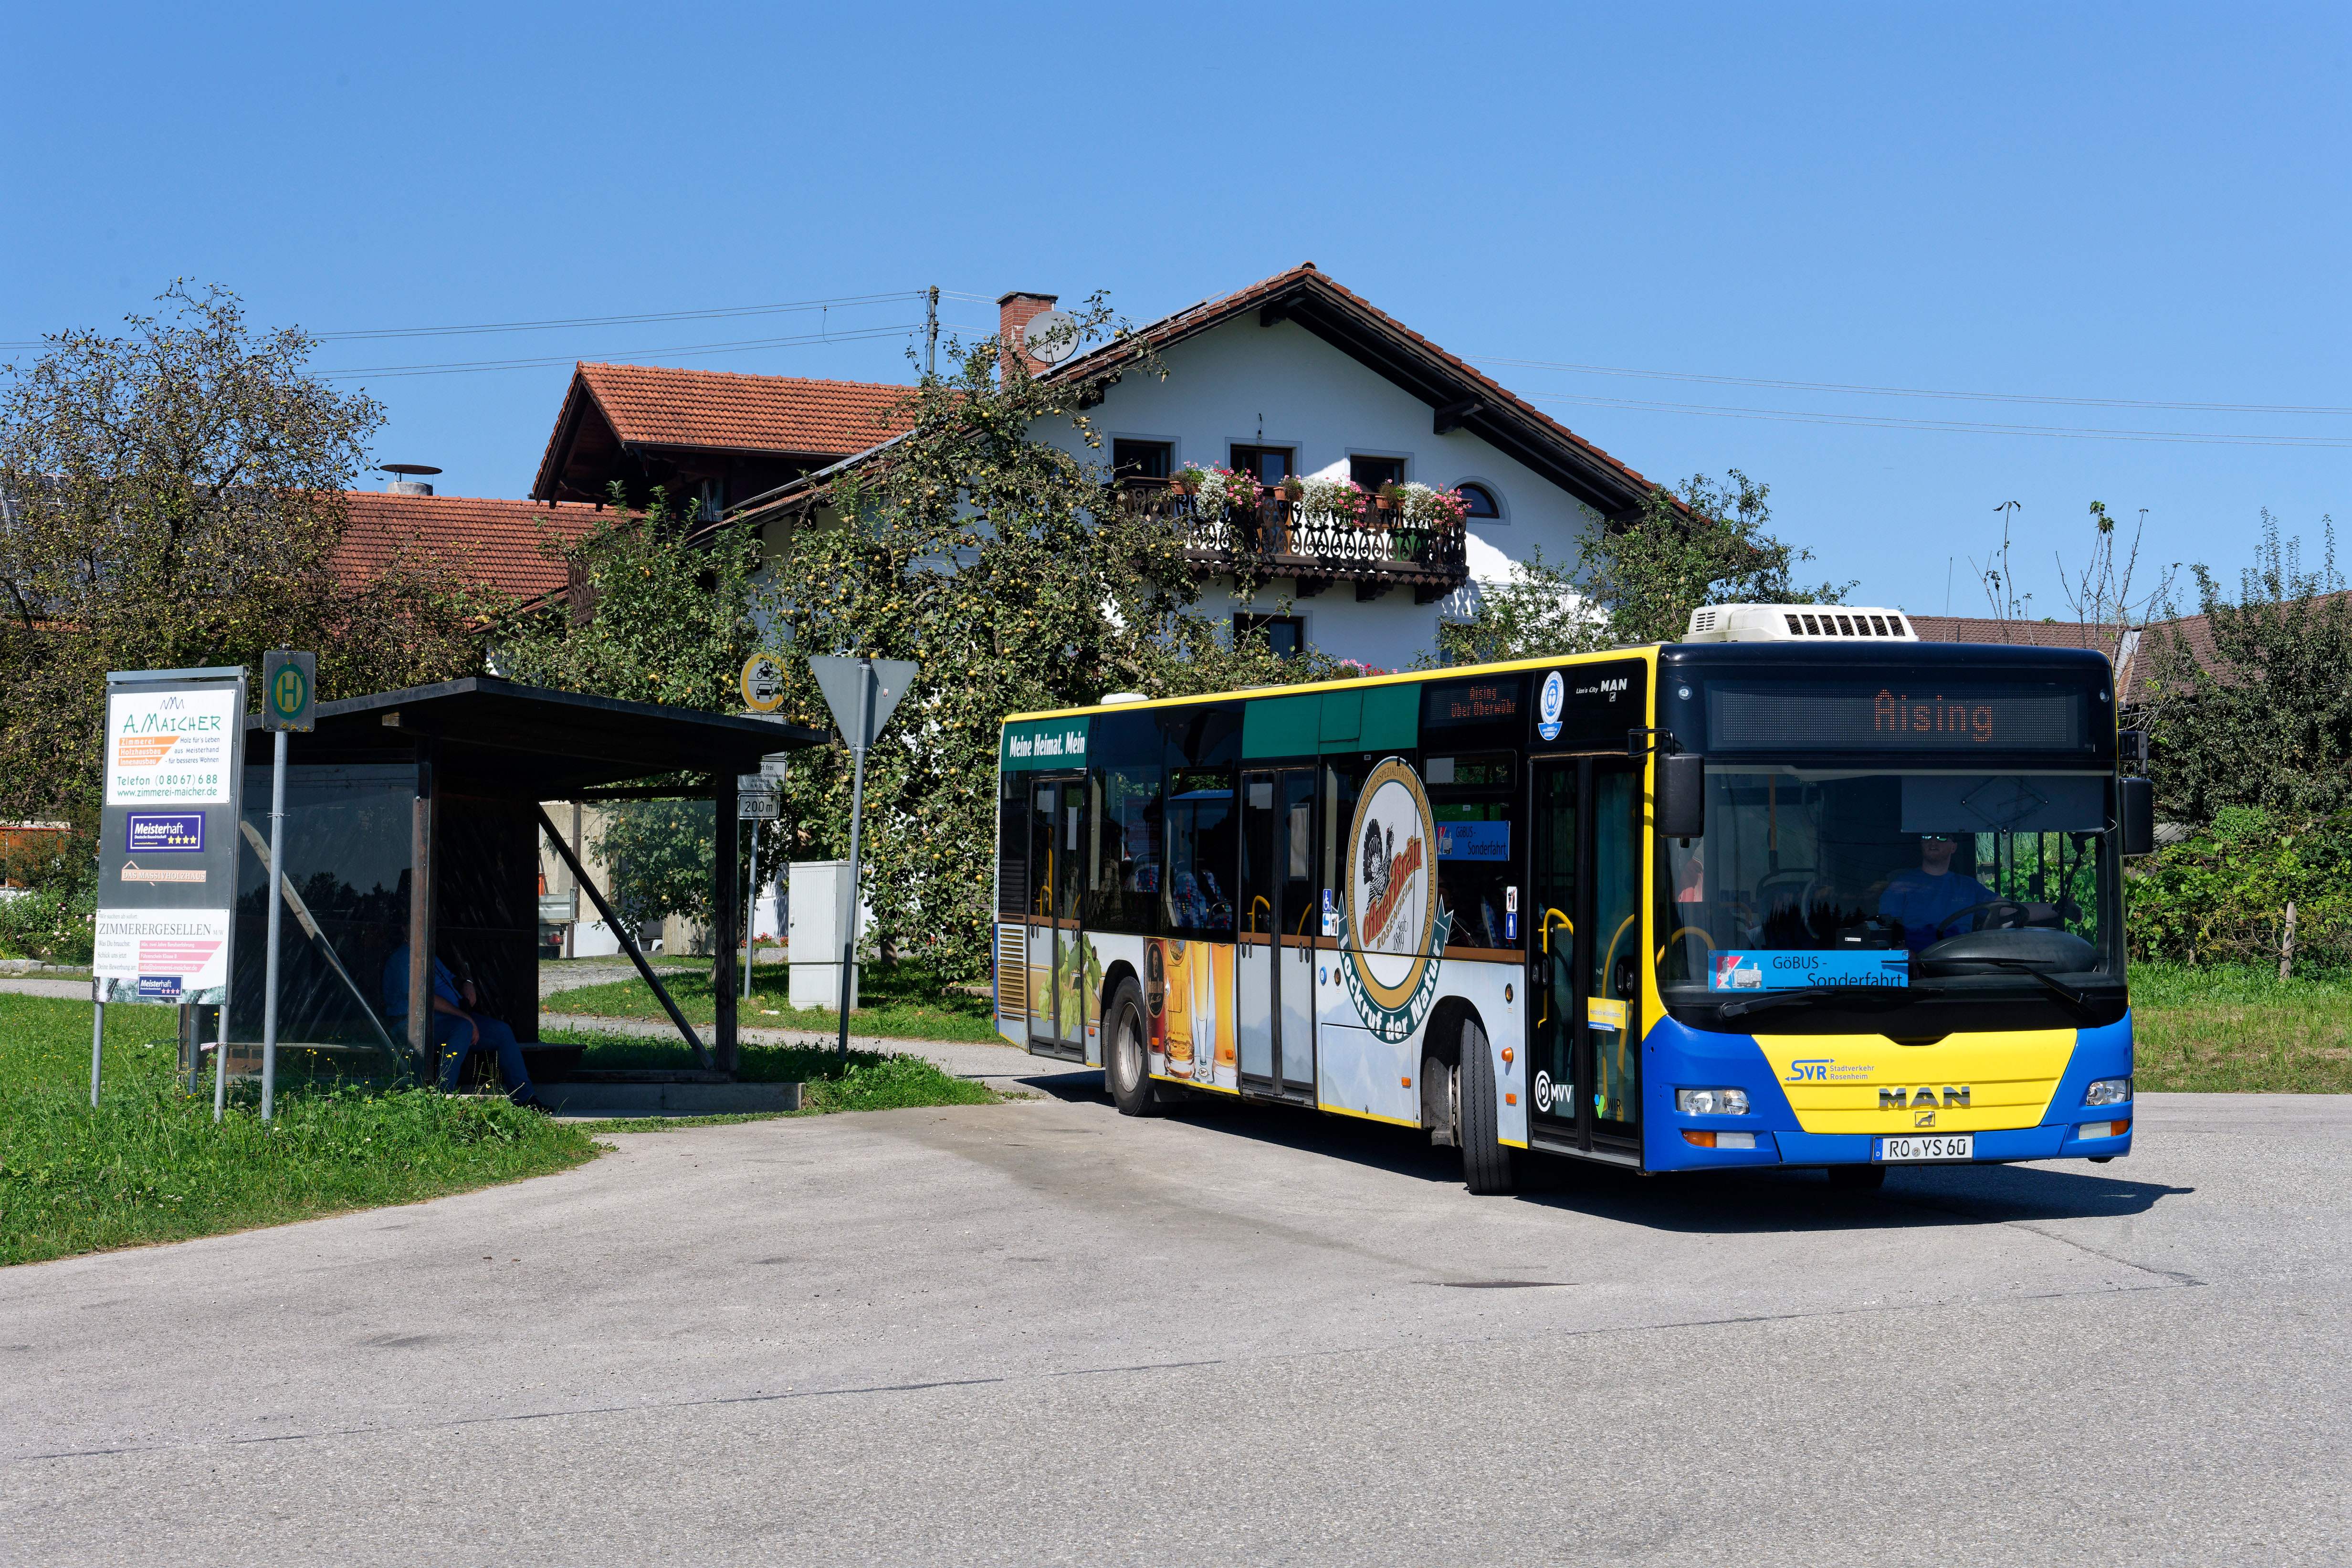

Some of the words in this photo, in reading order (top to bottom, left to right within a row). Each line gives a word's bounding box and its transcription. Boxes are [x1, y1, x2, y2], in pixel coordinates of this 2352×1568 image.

[282, 675, 297, 707] H
[1470, 685, 1497, 700] Aising
[1600, 678, 1628, 692] MAN
[1875, 689, 1992, 742] Aising
[120, 747, 161, 756] Holzhausbau
[1009, 735, 1032, 758] Meine
[1034, 733, 1063, 756] Heimat.
[1065, 731, 1085, 754] Mein
[117, 776, 150, 786] Telefon
[1369, 767, 1414, 793] BIERSPEZIALITÄTEN
[117, 787, 217, 797] www.zimmerei-maicher.de
[745, 801, 764, 812] 200
[766, 804, 773, 812] m
[134, 822, 184, 834] Meisterhaft
[1350, 793, 1370, 868] ROSENHEIMER
[1456, 826, 1473, 838] GöBUS
[1468, 841, 1506, 855] Sonderfahrt
[139, 872, 206, 880] MASSIVHOLZHAUS
[1424, 852, 1434, 939] OBERBAYERN
[1348, 875, 1356, 935] ORIGINAL
[1377, 876, 1413, 950] ROSENHEIM
[99, 923, 211, 935] ZIMMERERGESELLEN
[1392, 931, 1404, 954] 1889
[1773, 956, 1819, 969] GöBUS
[1340, 933, 1383, 1036] Lockruf
[1386, 1015, 1408, 1041] der
[1410, 938, 1440, 1026] Natur
[1807, 972, 1903, 987] Sonderfahrt
[1791, 1059, 1829, 1081] SVR
[1551, 1083, 1572, 1103] MVV
[1879, 1086, 1971, 1108] MAN
[1606, 1097, 1621, 1112] WIR
[1890, 1140, 1910, 1157] RO
[1922, 1139, 1942, 1156] YS
